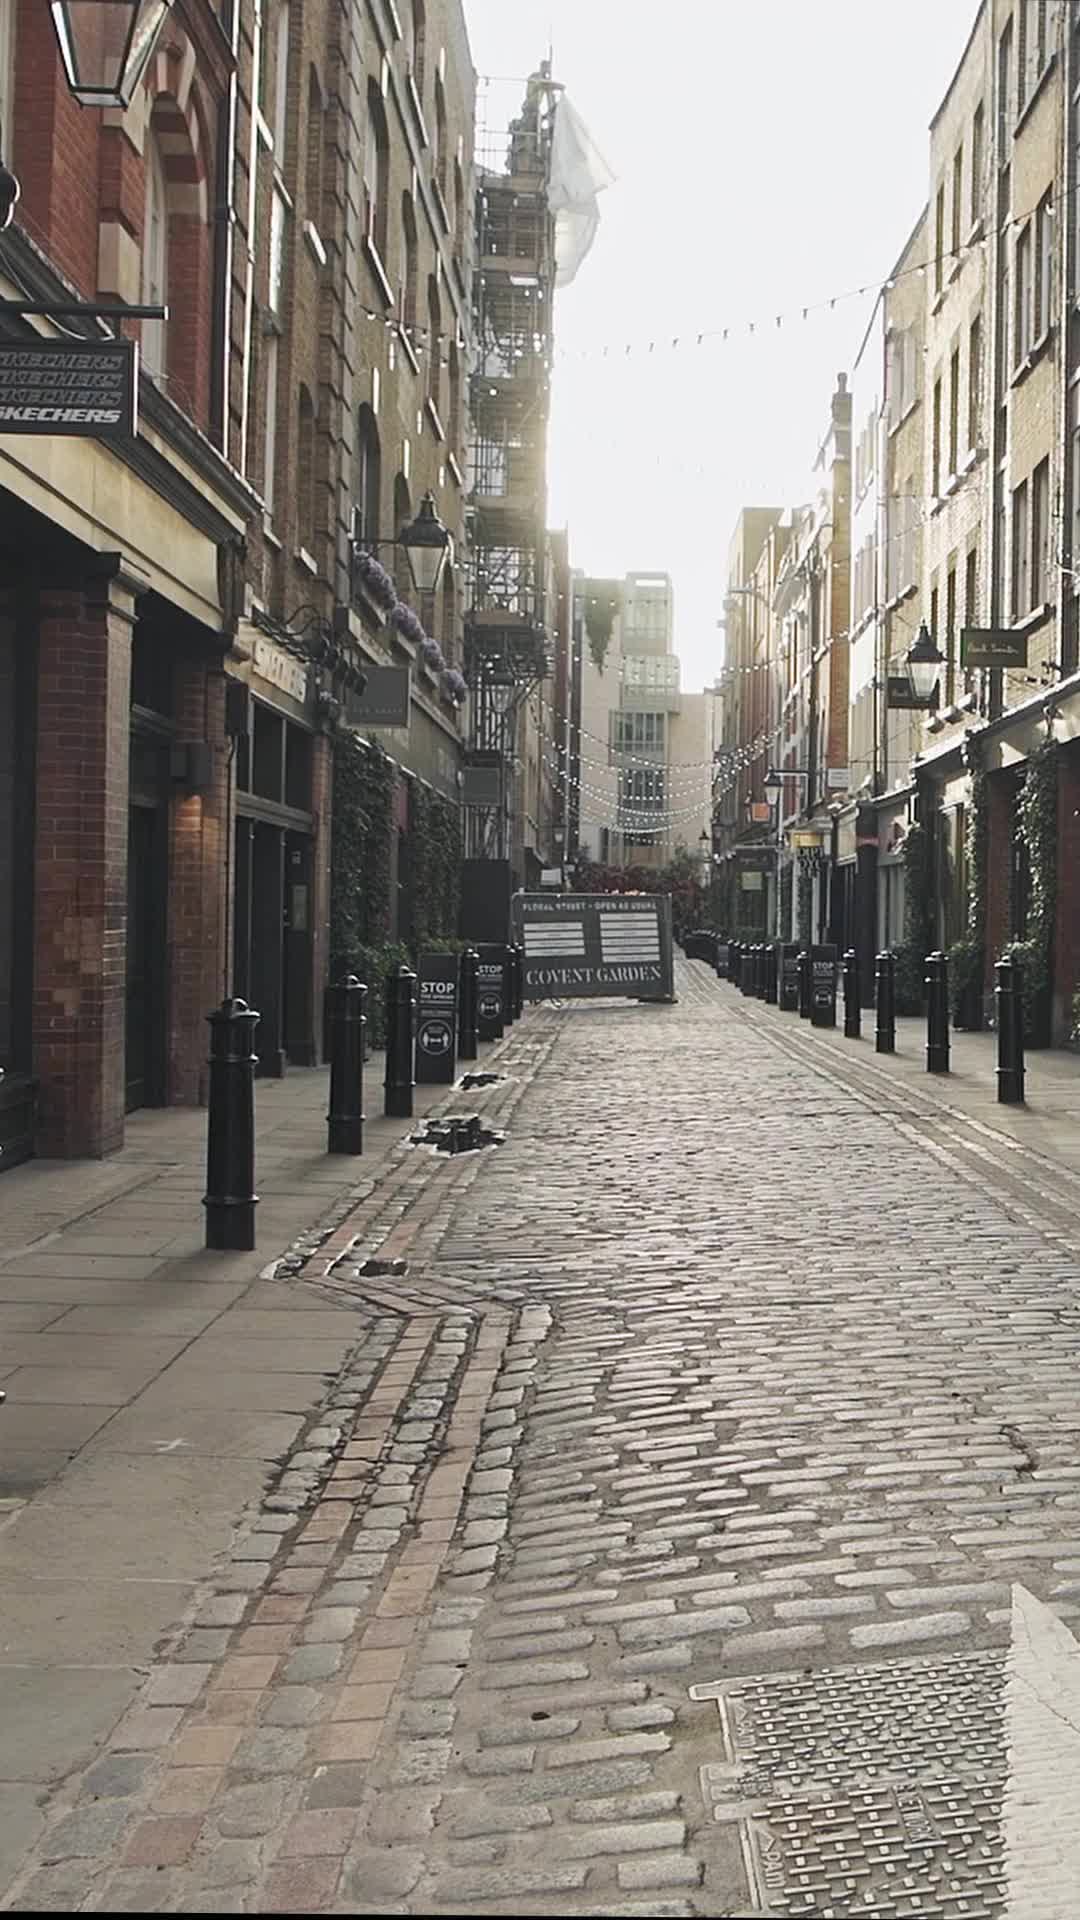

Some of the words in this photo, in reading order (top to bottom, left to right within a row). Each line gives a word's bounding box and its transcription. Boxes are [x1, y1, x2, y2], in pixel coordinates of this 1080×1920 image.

[594, 901, 616, 910] OPEN
[478, 965, 503, 974] STOP
[526, 967, 594, 985] COVENT
[596, 965, 662, 983] GARDEN
[420, 982, 455, 993] STOP
